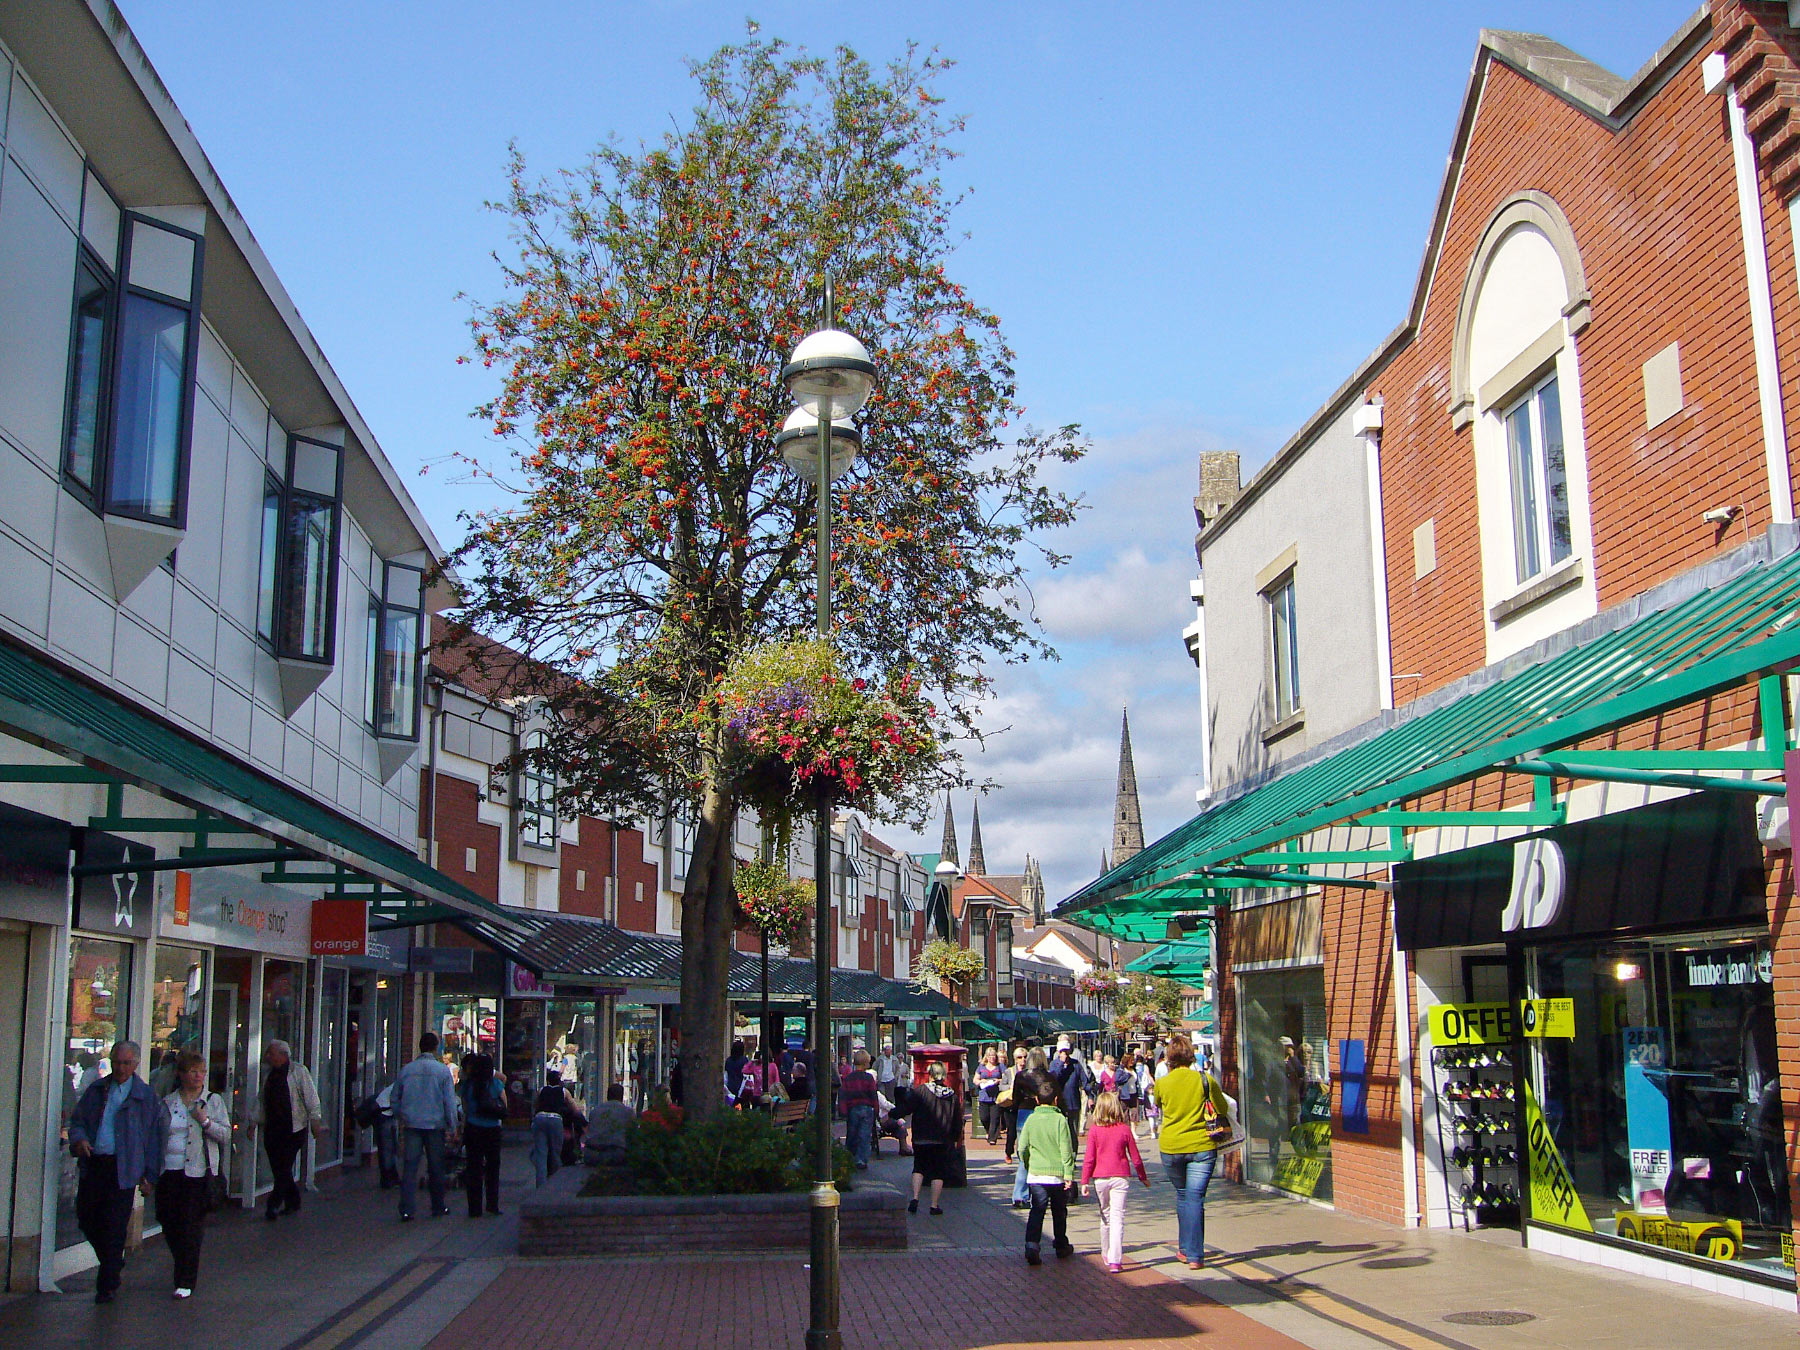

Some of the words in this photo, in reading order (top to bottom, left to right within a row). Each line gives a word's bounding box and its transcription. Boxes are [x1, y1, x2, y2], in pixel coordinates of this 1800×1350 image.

[1502, 837, 1566, 932] JD
[220, 896, 234, 923] the
[238, 899, 265, 934] Orange
[314, 940, 360, 951] orange
[1685, 951, 1757, 986] Timberland
[1628, 1032, 1636, 1044] 2
[1629, 1044, 1662, 1065] £20
[1633, 1151, 1667, 1165] FREE
[1531, 1118, 1573, 1223] OFFER
[1633, 1166, 1667, 1175] WALLET
[1706, 1237, 1735, 1261] JD
